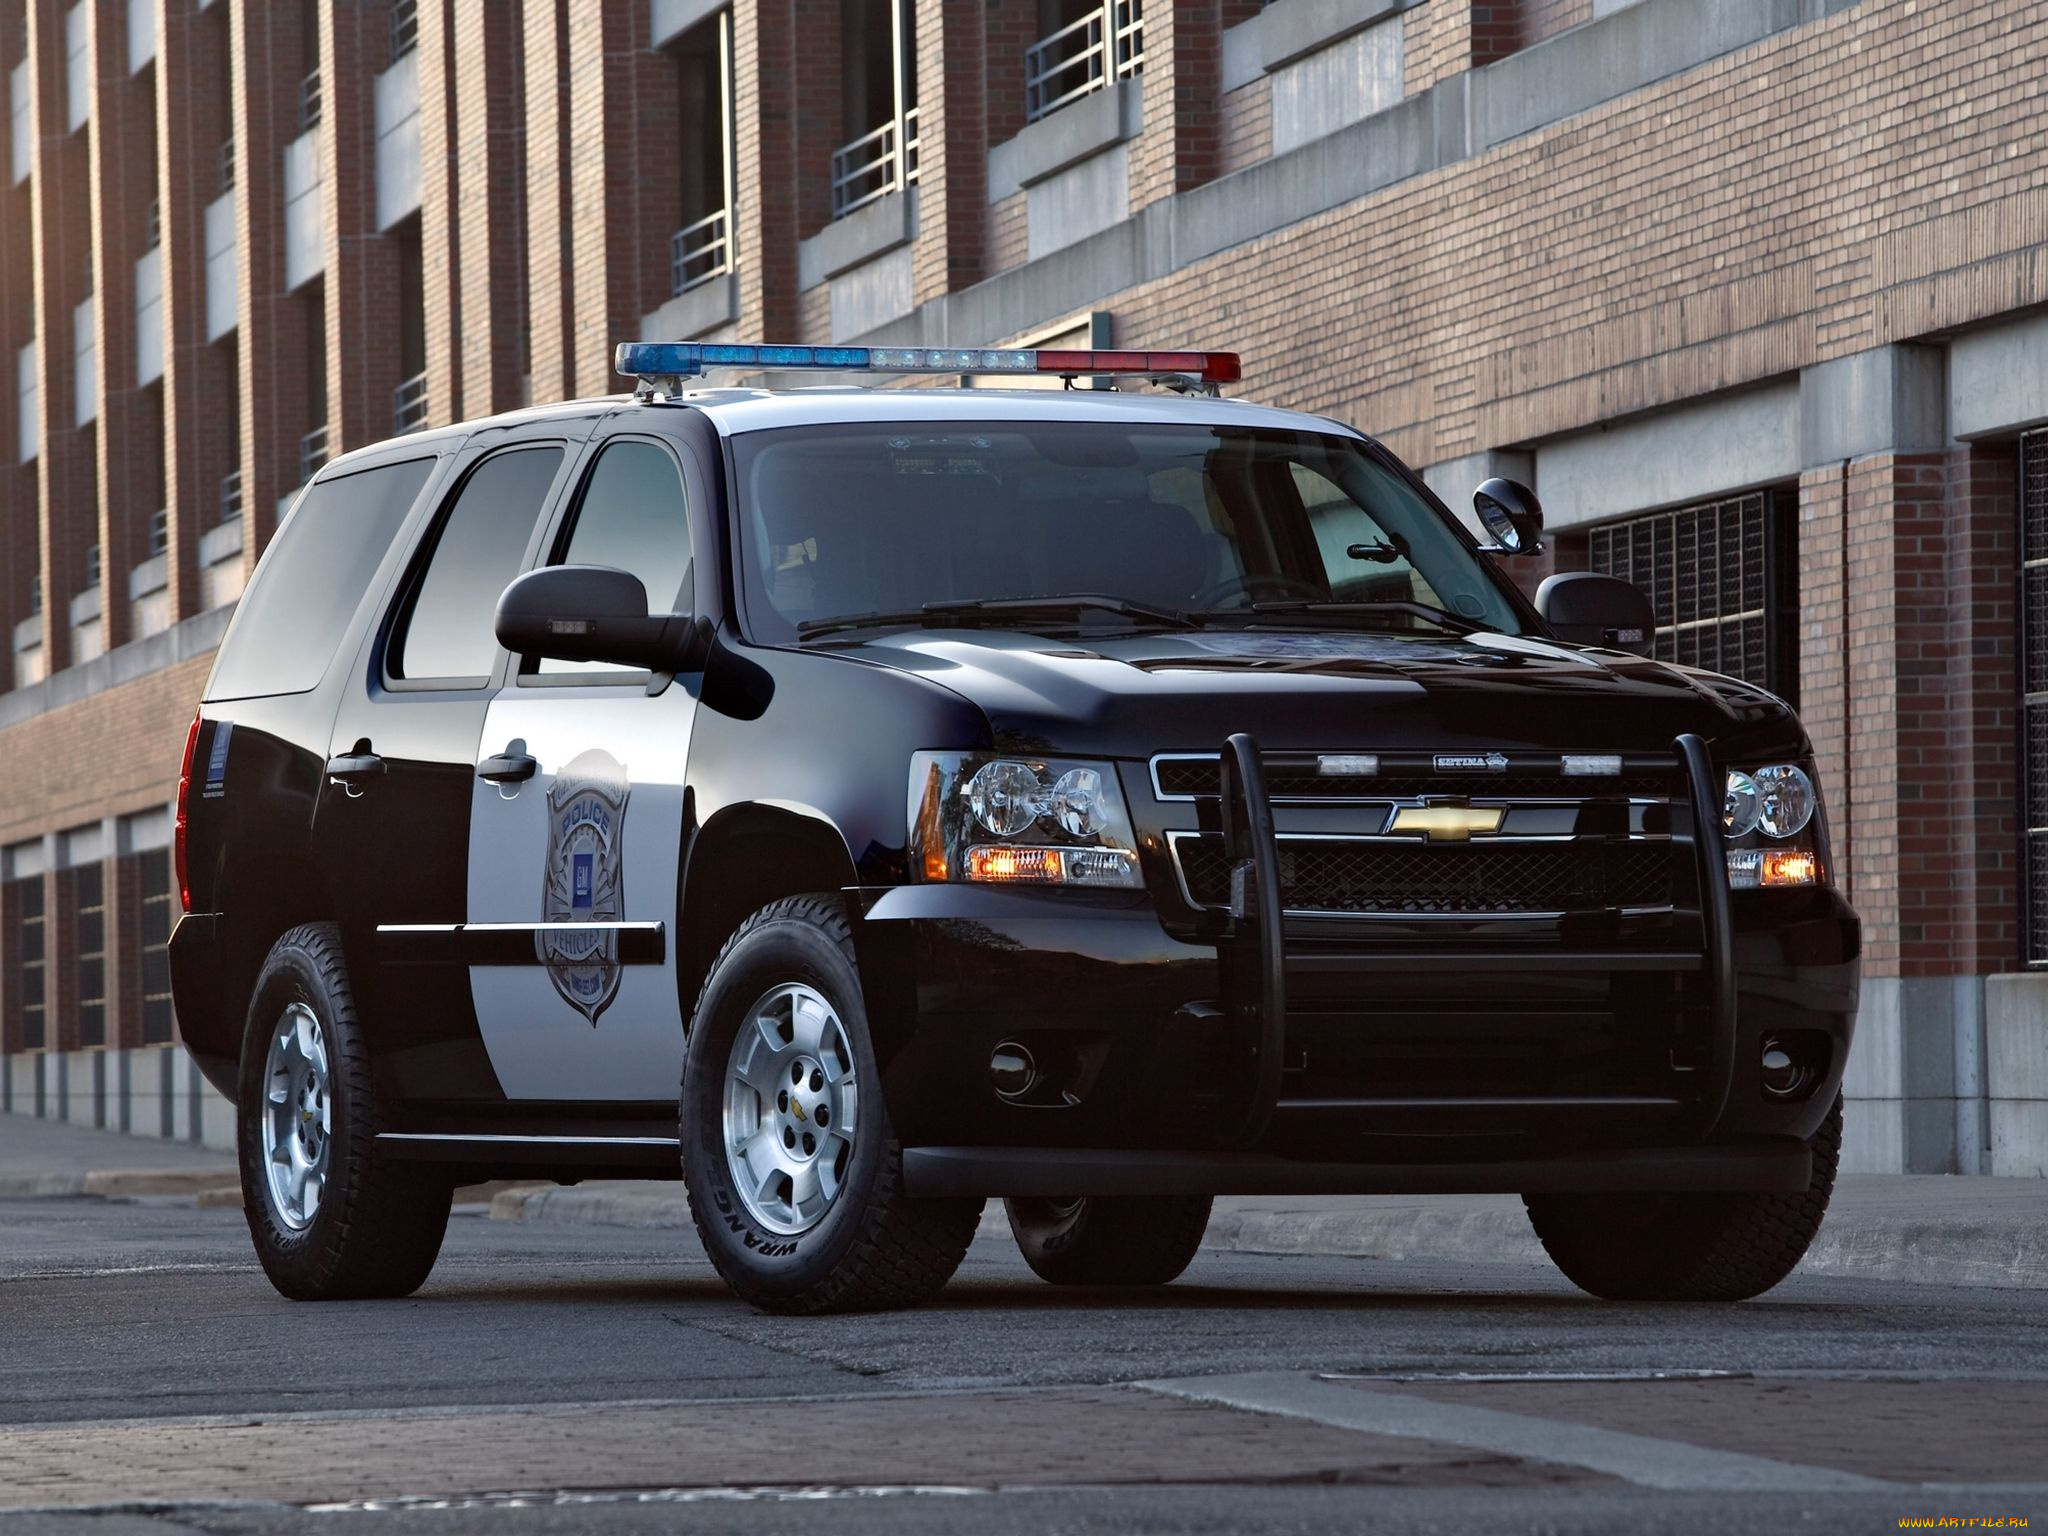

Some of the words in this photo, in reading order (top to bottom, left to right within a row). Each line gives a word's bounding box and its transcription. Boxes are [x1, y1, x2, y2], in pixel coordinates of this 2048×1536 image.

[1437, 757, 1486, 766] SETINA
[561, 799, 610, 838] POLICE
[576, 865, 589, 889] GM
